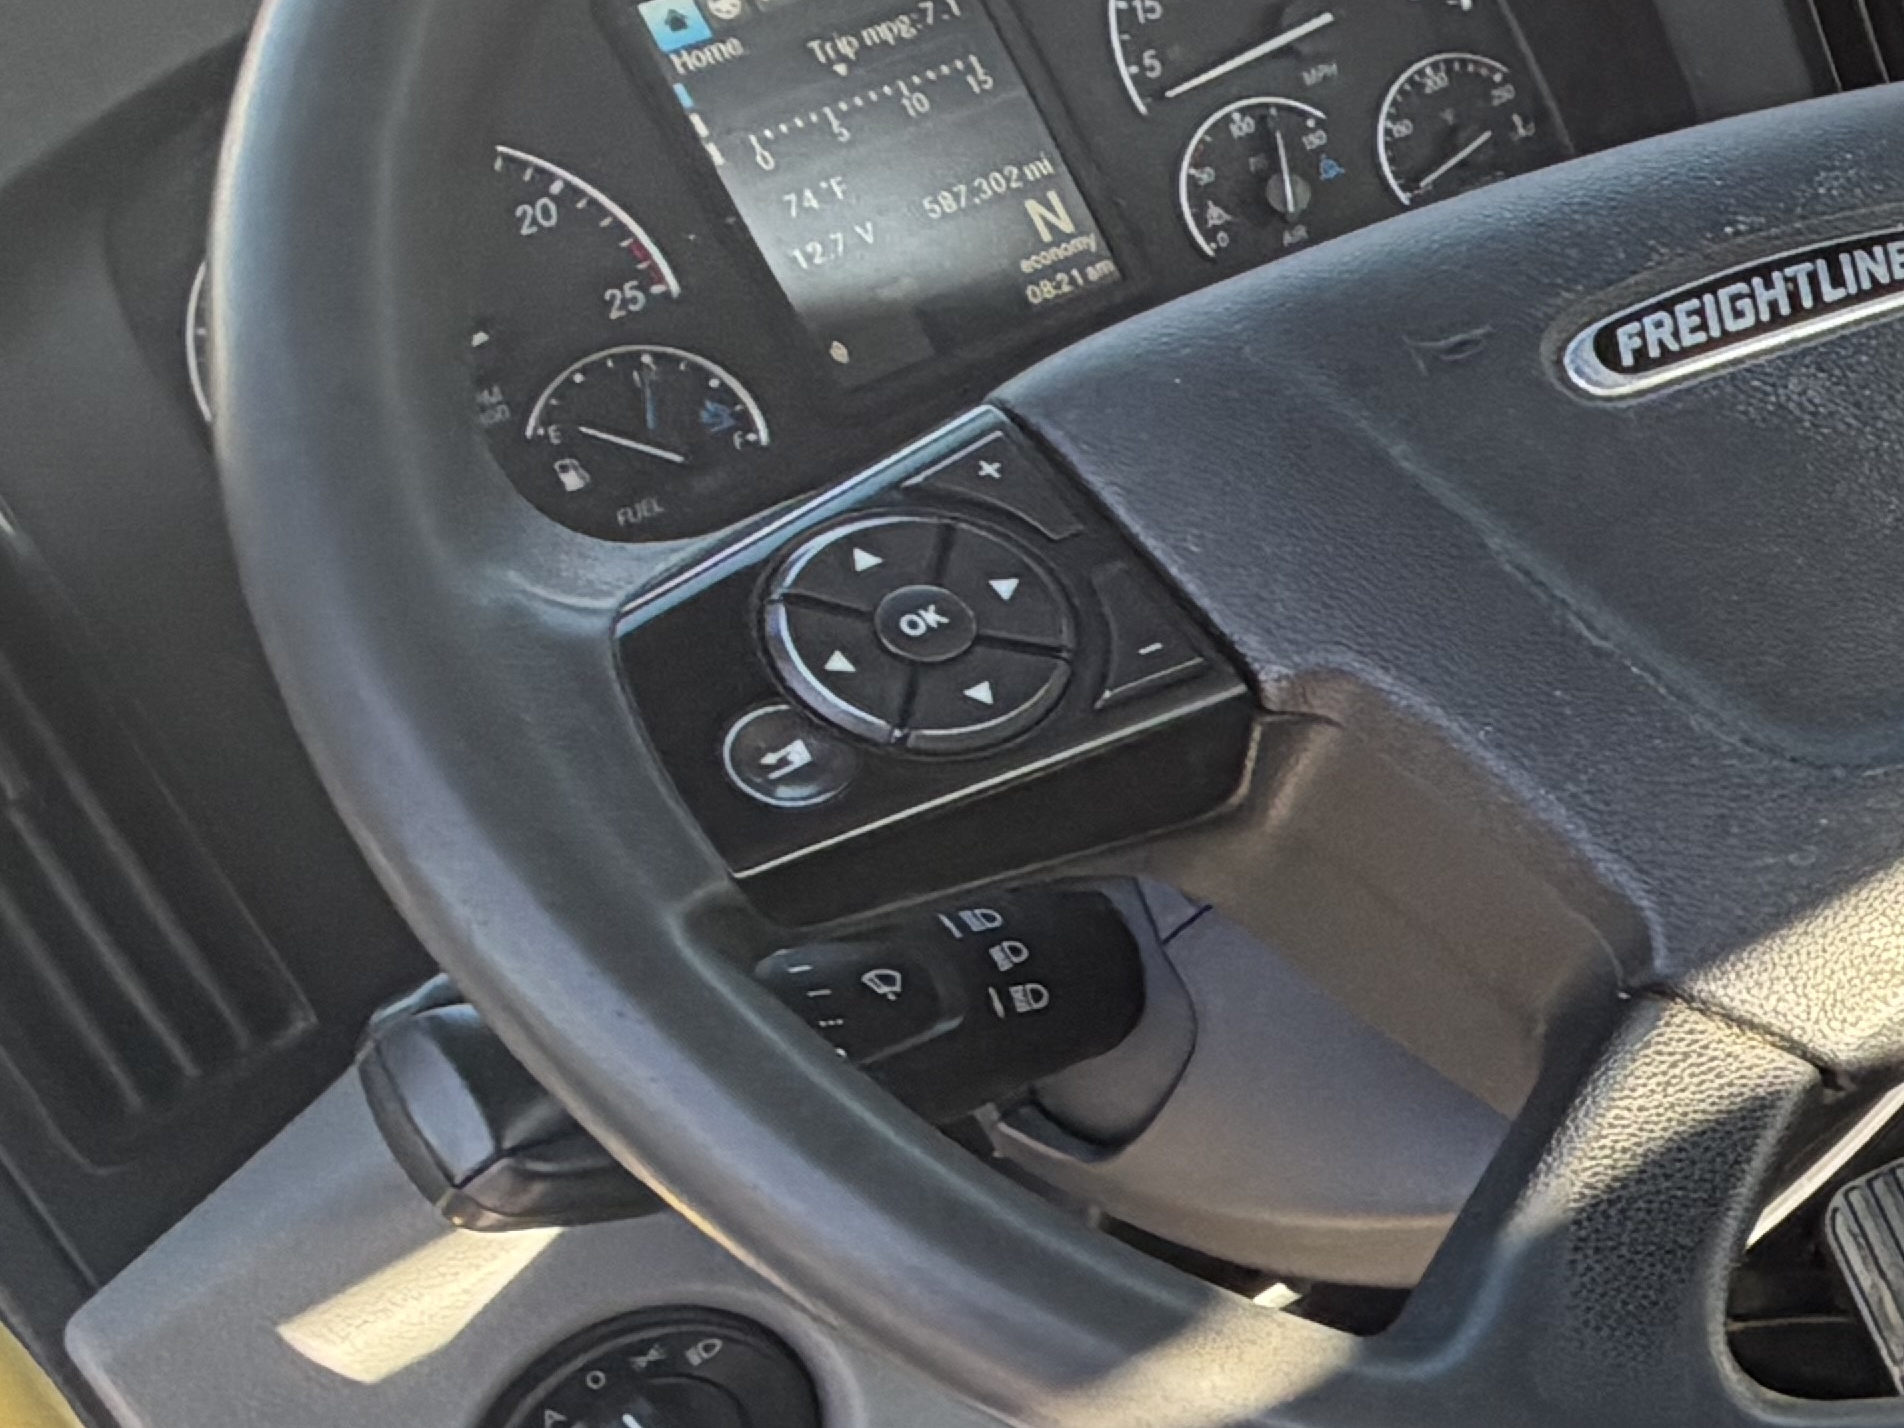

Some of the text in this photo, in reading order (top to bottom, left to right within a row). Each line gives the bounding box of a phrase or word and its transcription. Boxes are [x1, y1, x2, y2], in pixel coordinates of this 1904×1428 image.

[670, 36, 744, 76] Home
[806, 33, 860, 71] Trip
[1142, 48, 1163, 79] 5
[1303, 63, 1338, 86] MPH
[1023, 150, 1055, 182] mi
[514, 197, 559, 237] 20
[783, 187, 820, 219] 74
[1024, 190, 1076, 243] N
[788, 221, 875, 269] 12.7 V
[1020, 232, 1099, 274] economy
[1024, 258, 1117, 305] 08:21 am
[603, 280, 647, 320] 25
[548, 425, 563, 446] E
[732, 431, 745, 451] F
[615, 497, 666, 527] FUEL
[899, 603, 951, 638] OK
